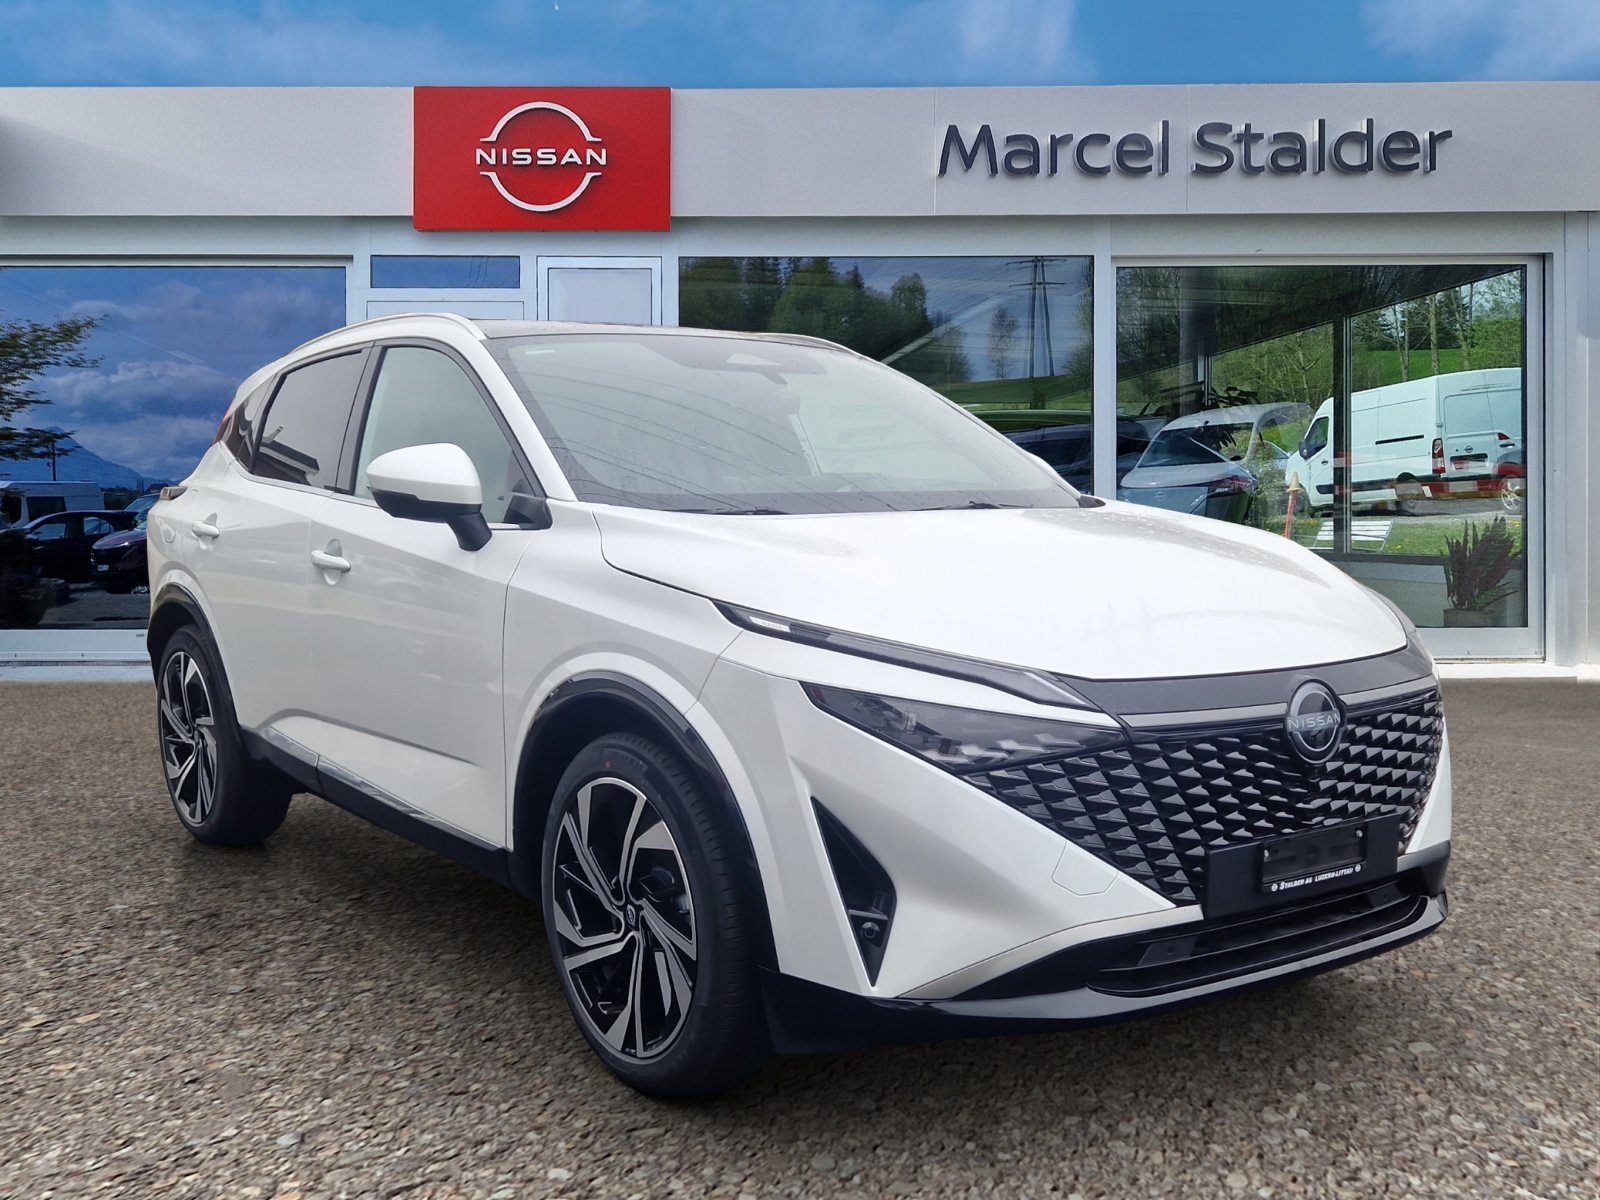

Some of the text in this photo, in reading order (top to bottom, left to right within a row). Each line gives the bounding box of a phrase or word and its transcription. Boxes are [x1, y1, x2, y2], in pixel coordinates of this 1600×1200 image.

[937, 118, 1453, 176] Marcel Stalder
[475, 148, 607, 165] NISSAN
[1288, 713, 1340, 729] NISSAN
